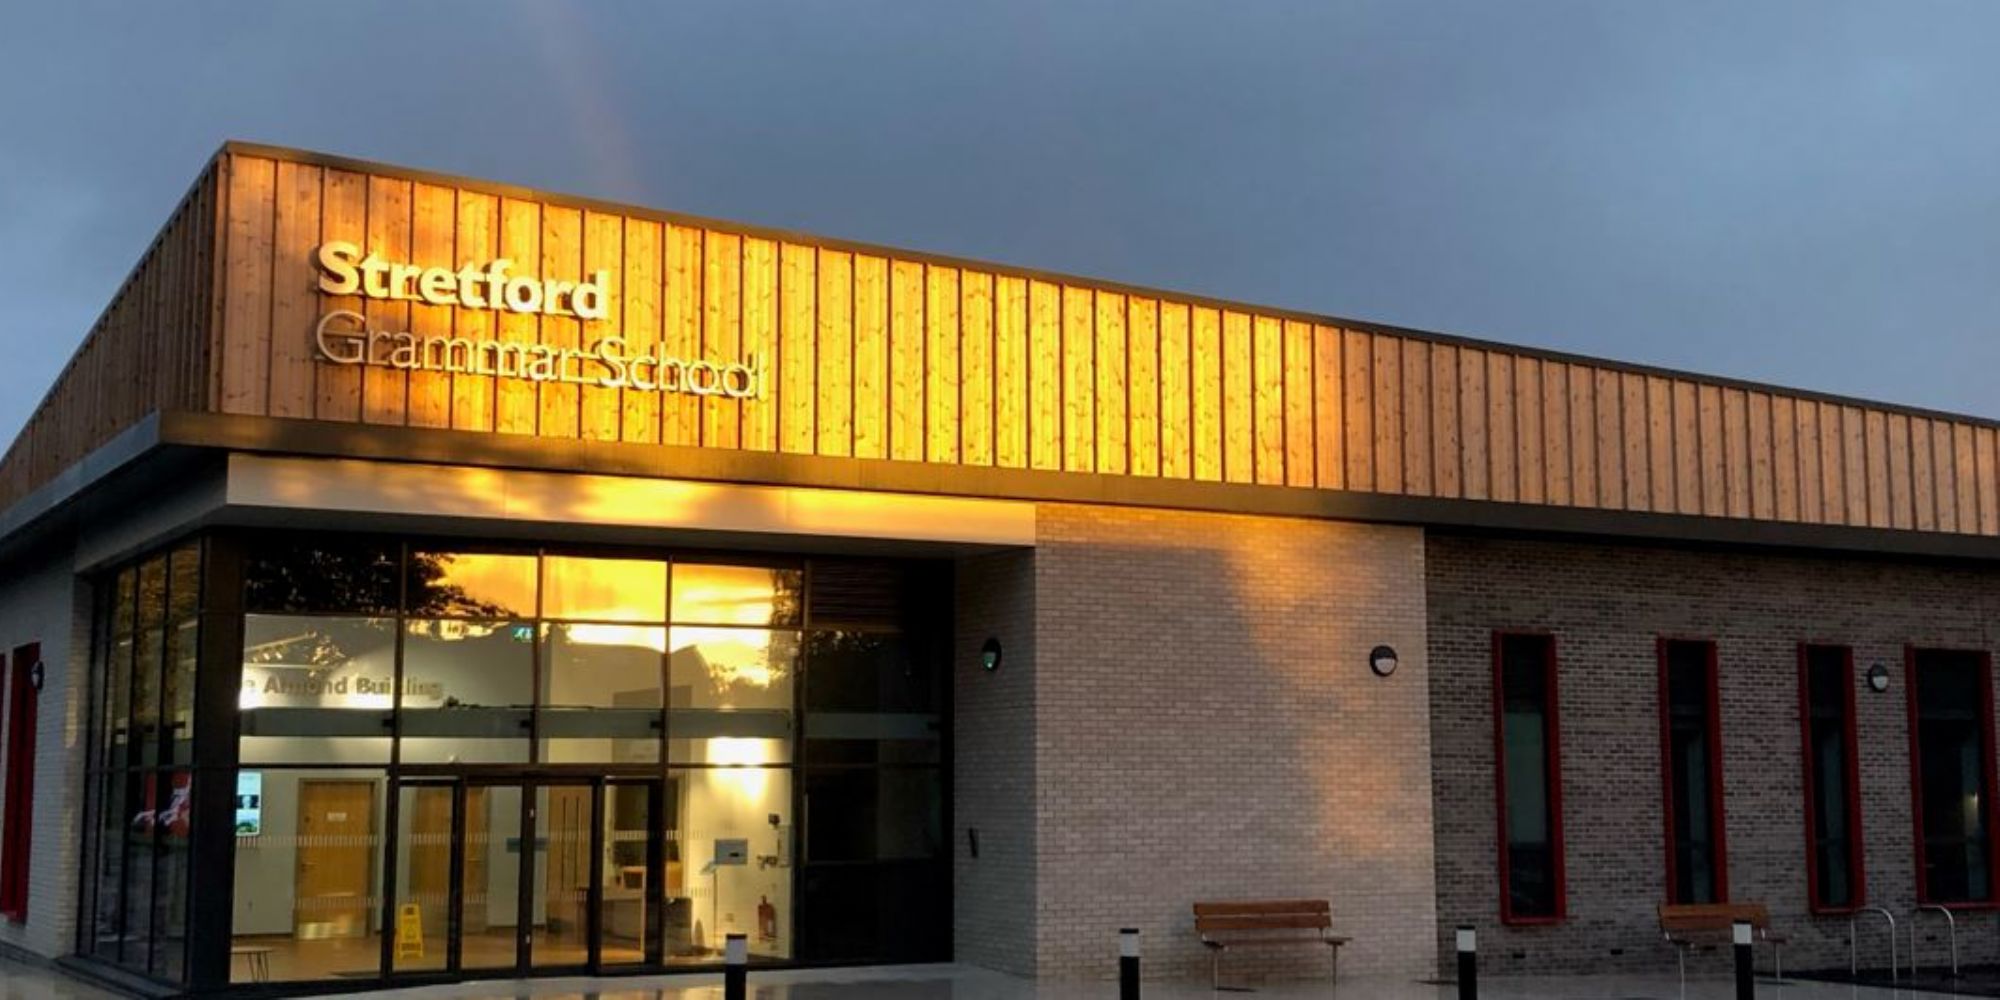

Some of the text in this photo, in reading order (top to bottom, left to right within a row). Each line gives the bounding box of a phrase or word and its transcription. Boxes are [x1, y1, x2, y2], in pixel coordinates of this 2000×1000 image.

[318, 241, 608, 319] Stretford
[316, 309, 765, 401] Grammar School
[356, 676, 443, 701] Buiing
